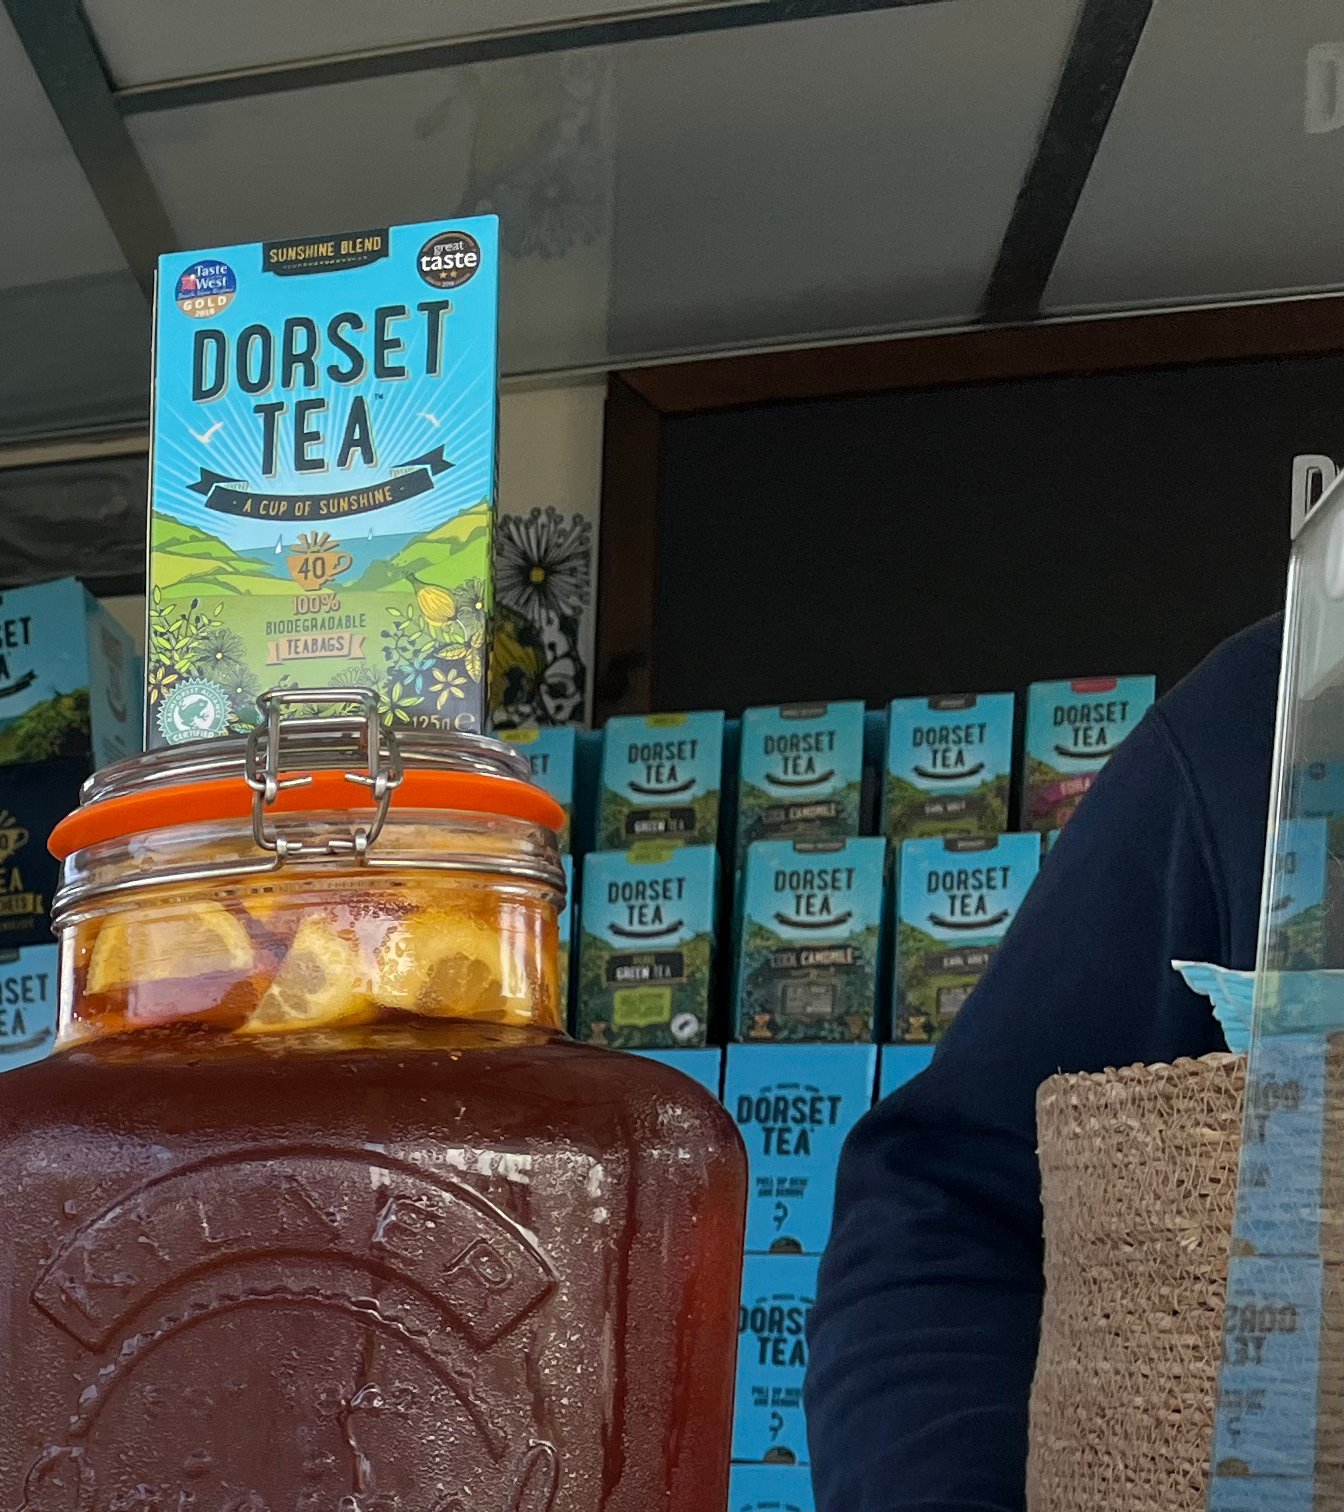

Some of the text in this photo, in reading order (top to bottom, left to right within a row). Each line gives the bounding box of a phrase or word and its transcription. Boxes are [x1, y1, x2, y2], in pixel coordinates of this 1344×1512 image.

[269, 243, 335, 263] SUNSHINE
[340, 236, 382, 254] BLEND
[433, 241, 464, 255] great
[195, 265, 228, 277] Taste
[420, 252, 477, 272] taste
[196, 276, 226, 290] West
[183, 296, 227, 311] GOLD
[192, 300, 452, 404] DORSET
[253, 396, 377, 478] TEA
[243, 487, 393, 516] A CUP OF SUNSHINE
[297, 557, 326, 580] 40
[291, 593, 340, 615] 100%
[265, 614, 367, 636] BIODEGRADABLE
[286, 636, 346, 655] TEABAGS
[1053, 701, 1130, 727] DORSET
[173, 731, 215, 741] CERTIFIED
[764, 731, 837, 755] DORSET
[912, 722, 987, 747] DORSET
[1071, 725, 1108, 747] TEA
[628, 740, 698, 764] DORSET
[931, 746, 966, 769] TEA
[646, 763, 678, 784] TEA
[781, 754, 817, 776] TEA
[607, 876, 686, 904] DORSET
[774, 867, 856, 893] DORSET
[927, 866, 1011, 894] DORSET
[627, 904, 663, 927] TEA
[794, 894, 832, 917] TEA
[947, 894, 988, 918] TEA
[737, 1095, 843, 1125] DORSET
[762, 1126, 812, 1157] TEA
[738, 1305, 812, 1335] DORS
[758, 1336, 806, 1366] TEA
